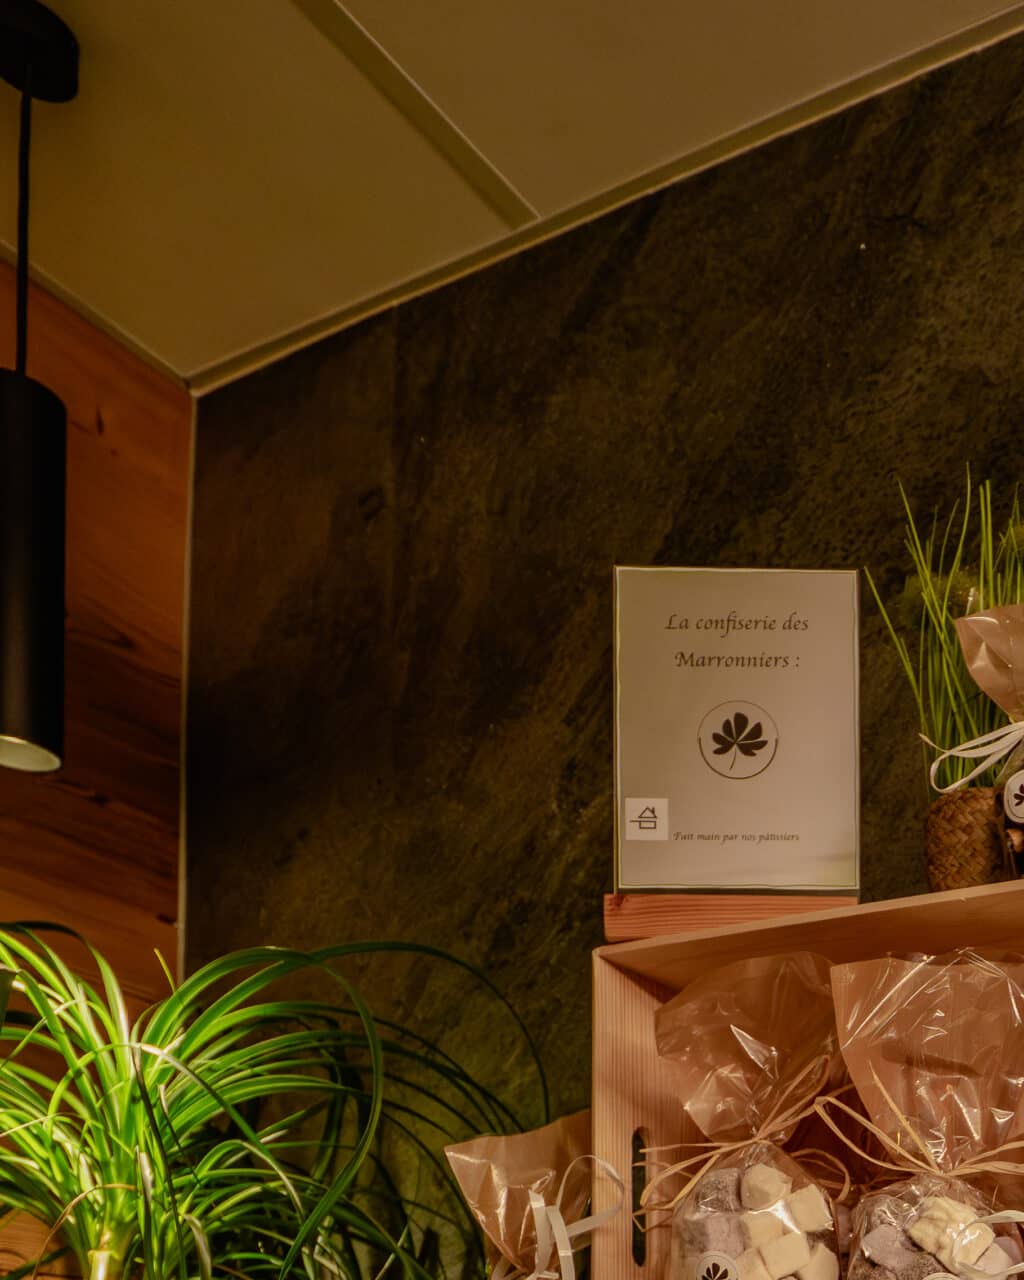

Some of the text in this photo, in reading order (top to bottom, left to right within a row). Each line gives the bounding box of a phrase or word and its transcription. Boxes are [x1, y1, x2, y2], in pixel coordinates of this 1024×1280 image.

[664, 610, 809, 638] La confiserie des
[674, 651, 790, 668] Marronniers
[673, 831, 694, 841] Fait
[697, 831, 720, 841] main
[720, 832, 739, 847] par
[740, 832, 756, 841] nos
